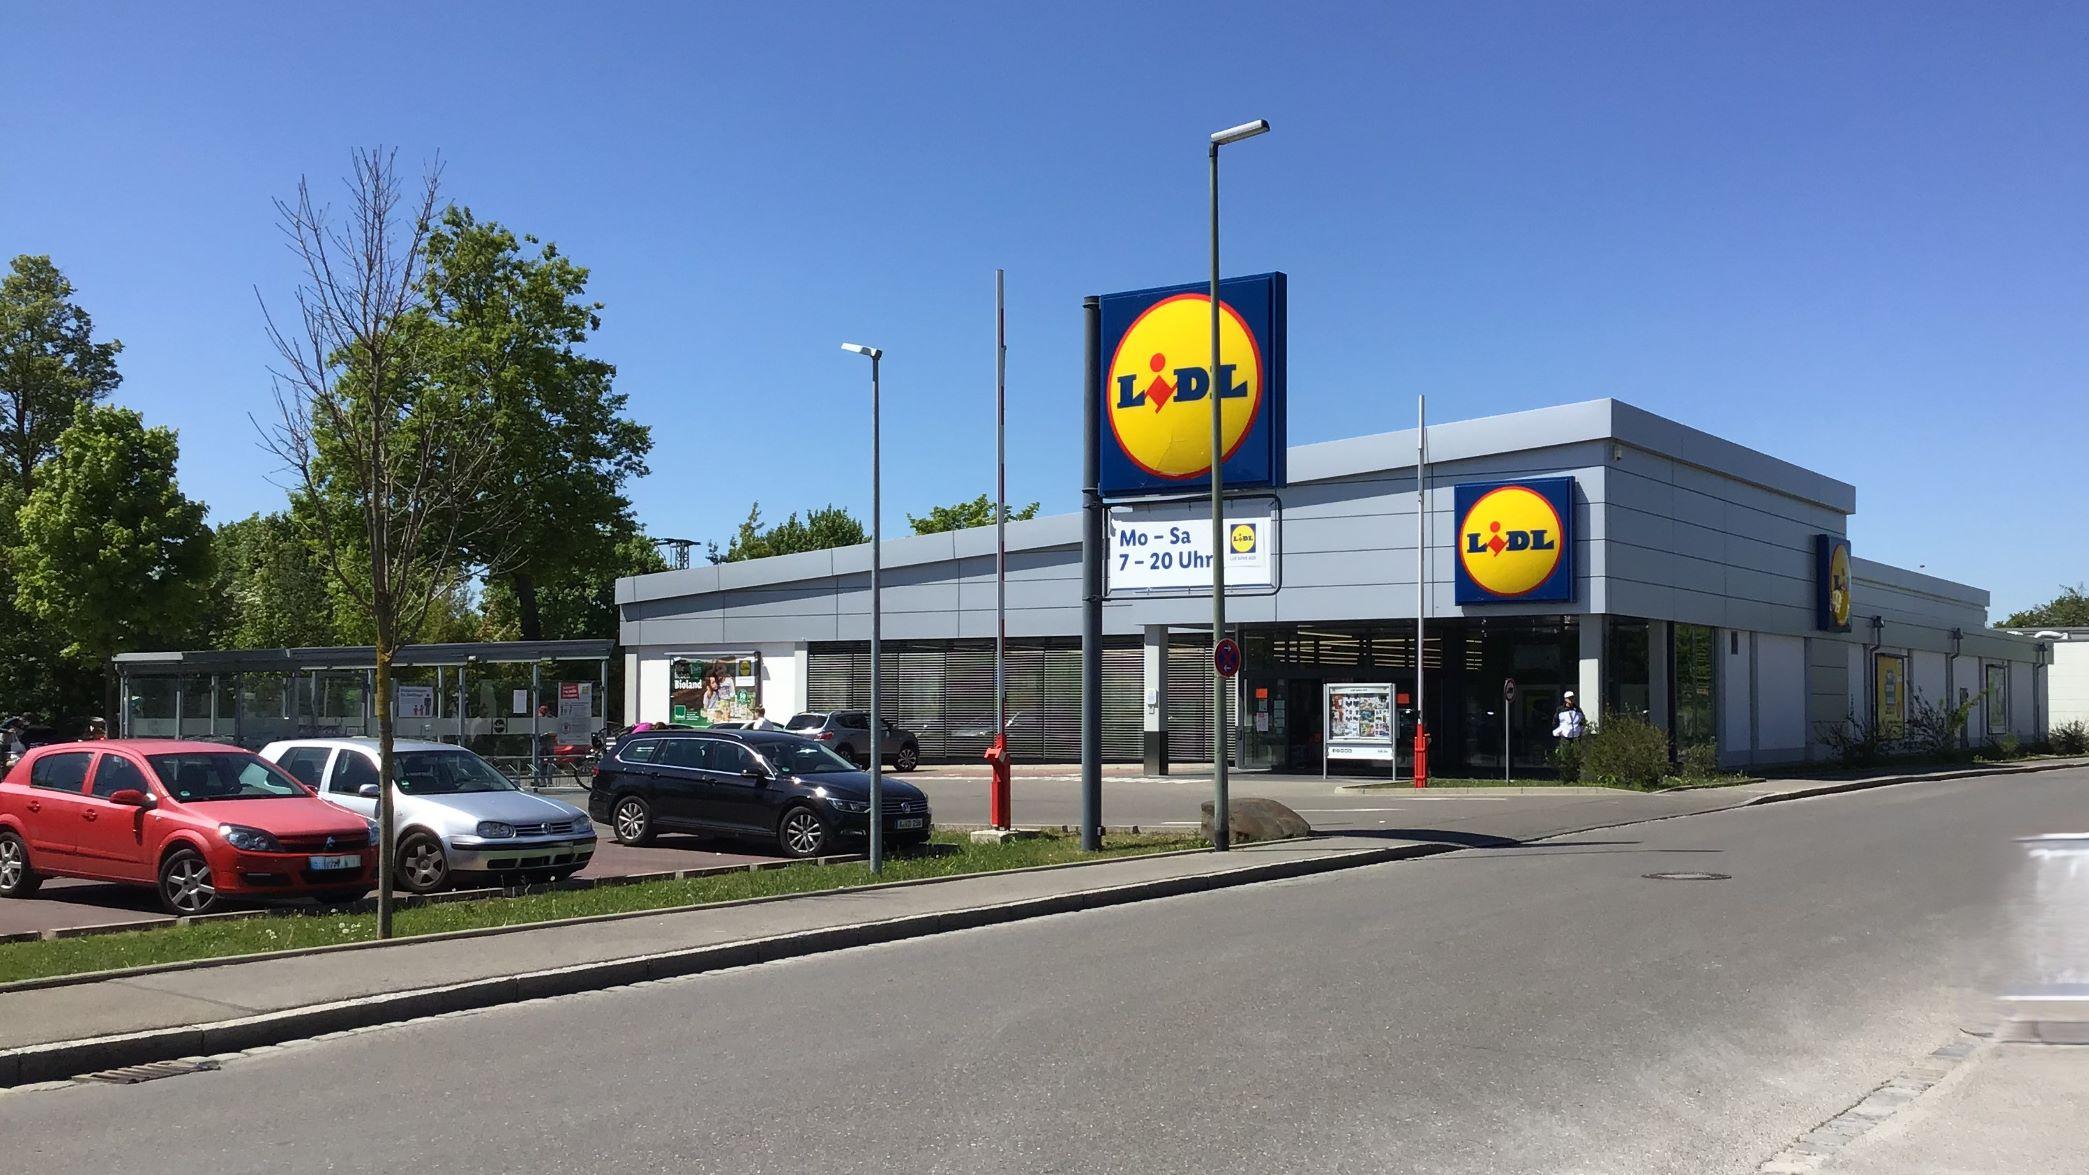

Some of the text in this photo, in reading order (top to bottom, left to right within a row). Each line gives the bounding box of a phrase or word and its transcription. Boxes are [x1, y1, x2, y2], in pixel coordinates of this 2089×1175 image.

[1120, 529, 1148, 547] Mo
[1170, 527, 1191, 545] Sa
[1119, 553, 1129, 571] 7
[1150, 552, 1173, 570] 20
[1179, 550, 1213, 569] Uhr
[674, 679, 703, 690] Bioland
